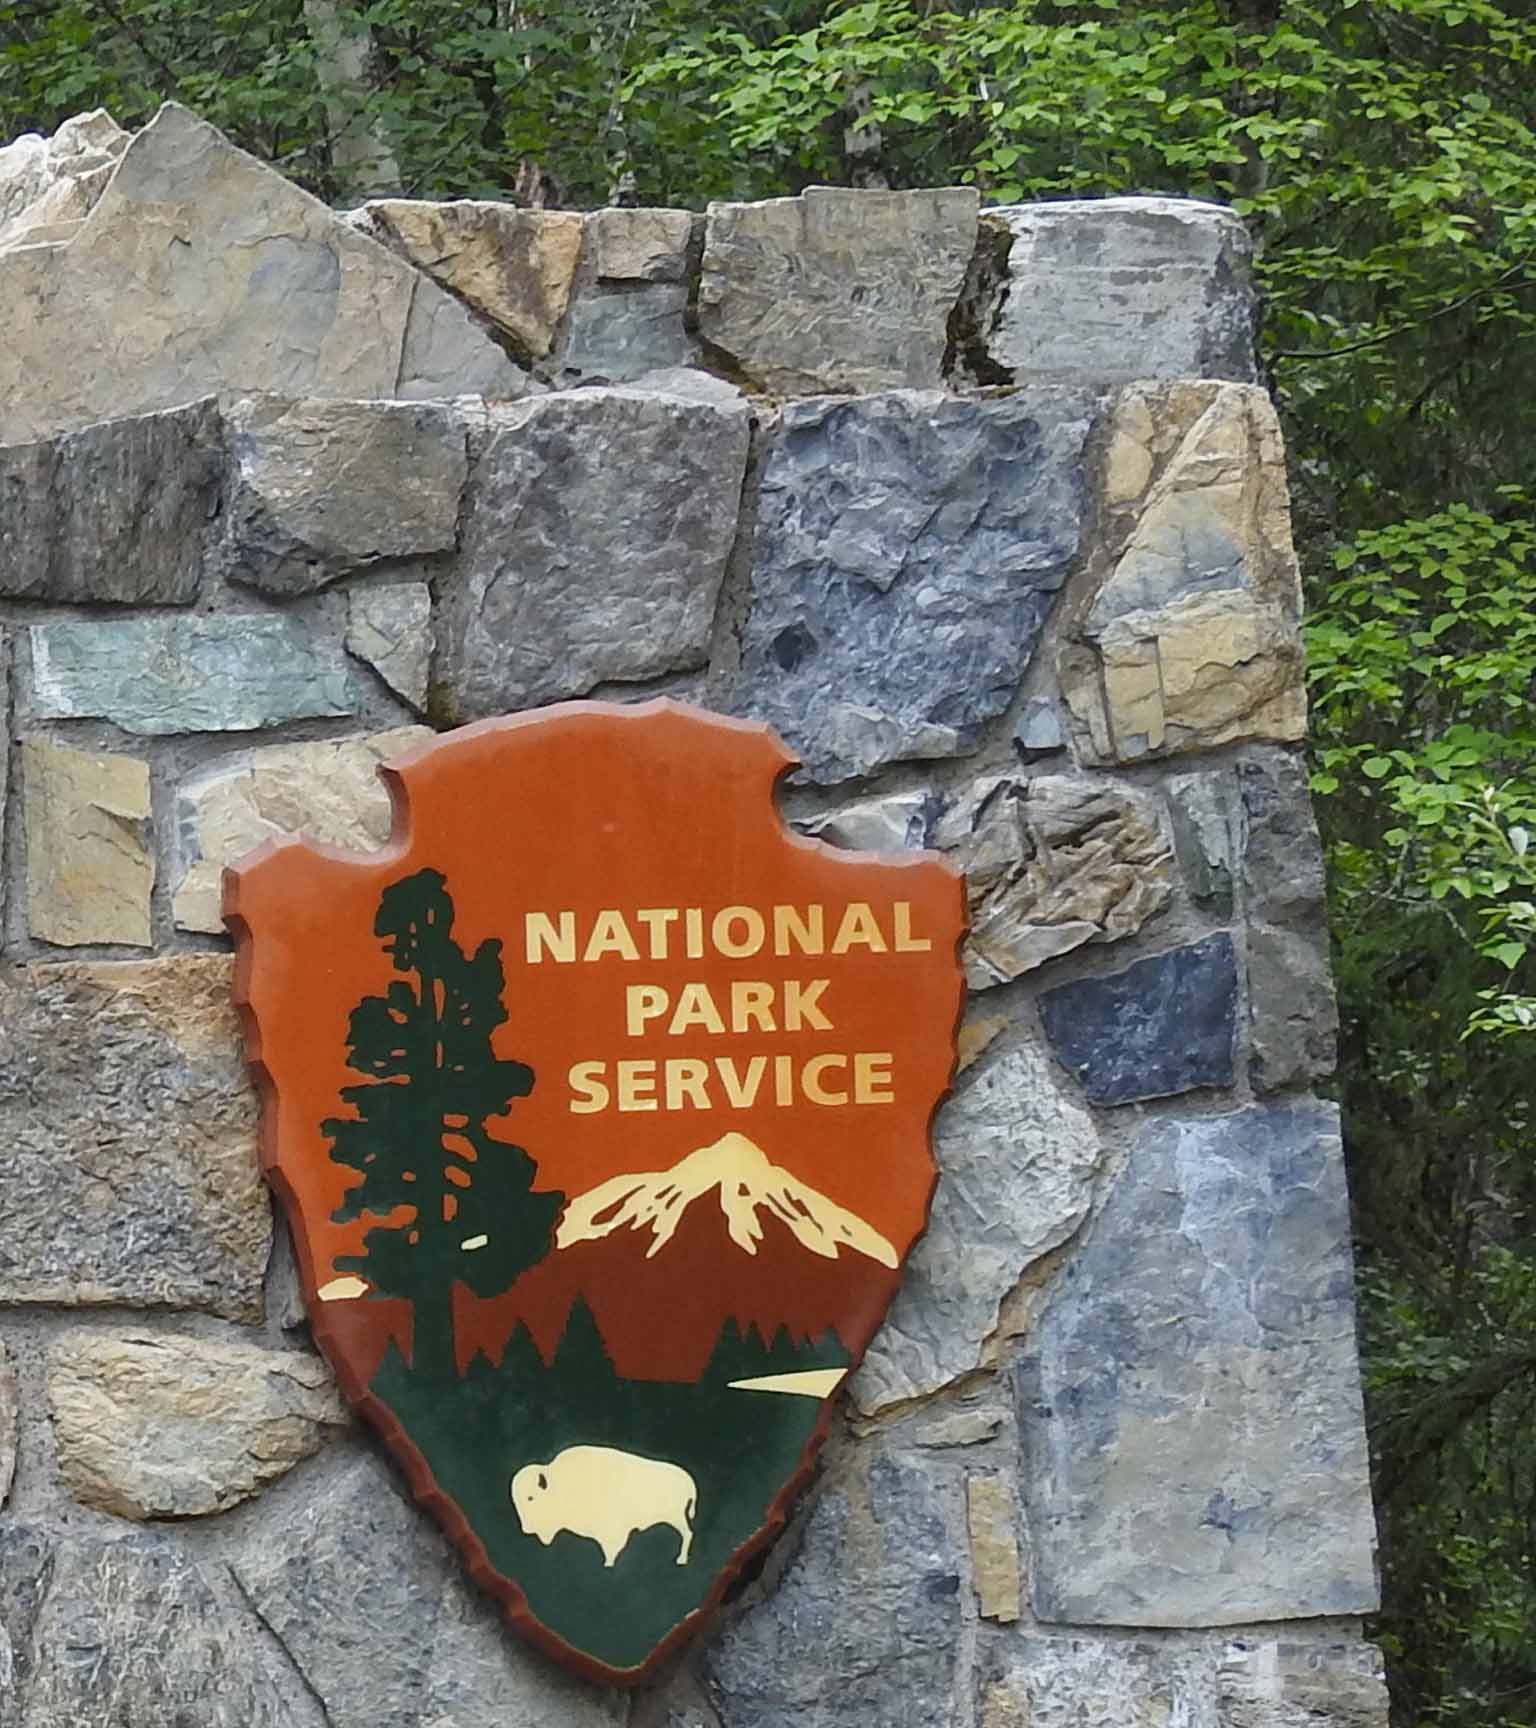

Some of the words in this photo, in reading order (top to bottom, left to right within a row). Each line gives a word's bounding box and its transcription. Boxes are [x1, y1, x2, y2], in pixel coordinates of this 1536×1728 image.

[524, 901, 932, 964] NATIONAL
[626, 979, 833, 1036] PARK
[567, 1053, 896, 1114] SERVICE
